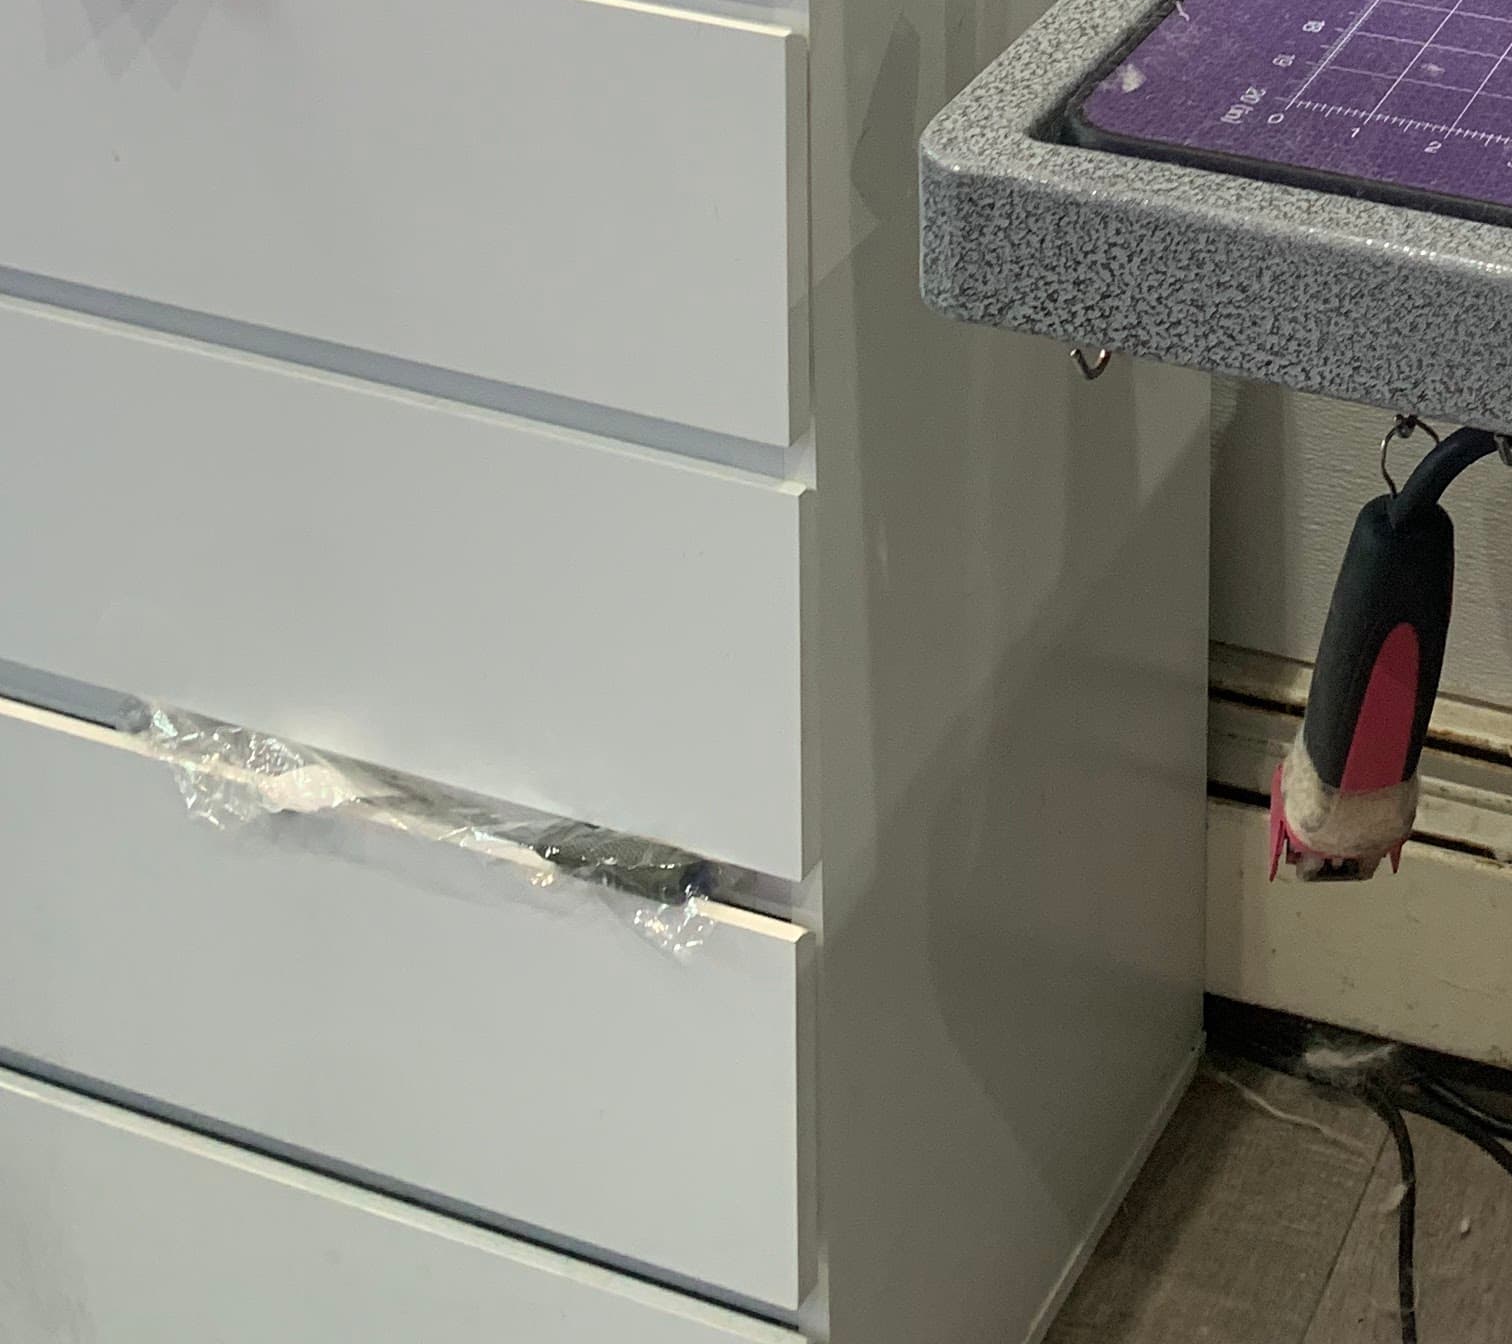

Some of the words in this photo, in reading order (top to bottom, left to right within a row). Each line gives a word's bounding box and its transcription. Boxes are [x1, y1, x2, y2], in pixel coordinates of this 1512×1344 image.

[1302, 19, 1325, 33] 18
[1272, 54, 1296, 68] 19
[1240, 86, 1267, 104] 20
[1267, 113, 1285, 124] 0
[1351, 127, 1361, 138] 1
[1424, 141, 1442, 153] 2
